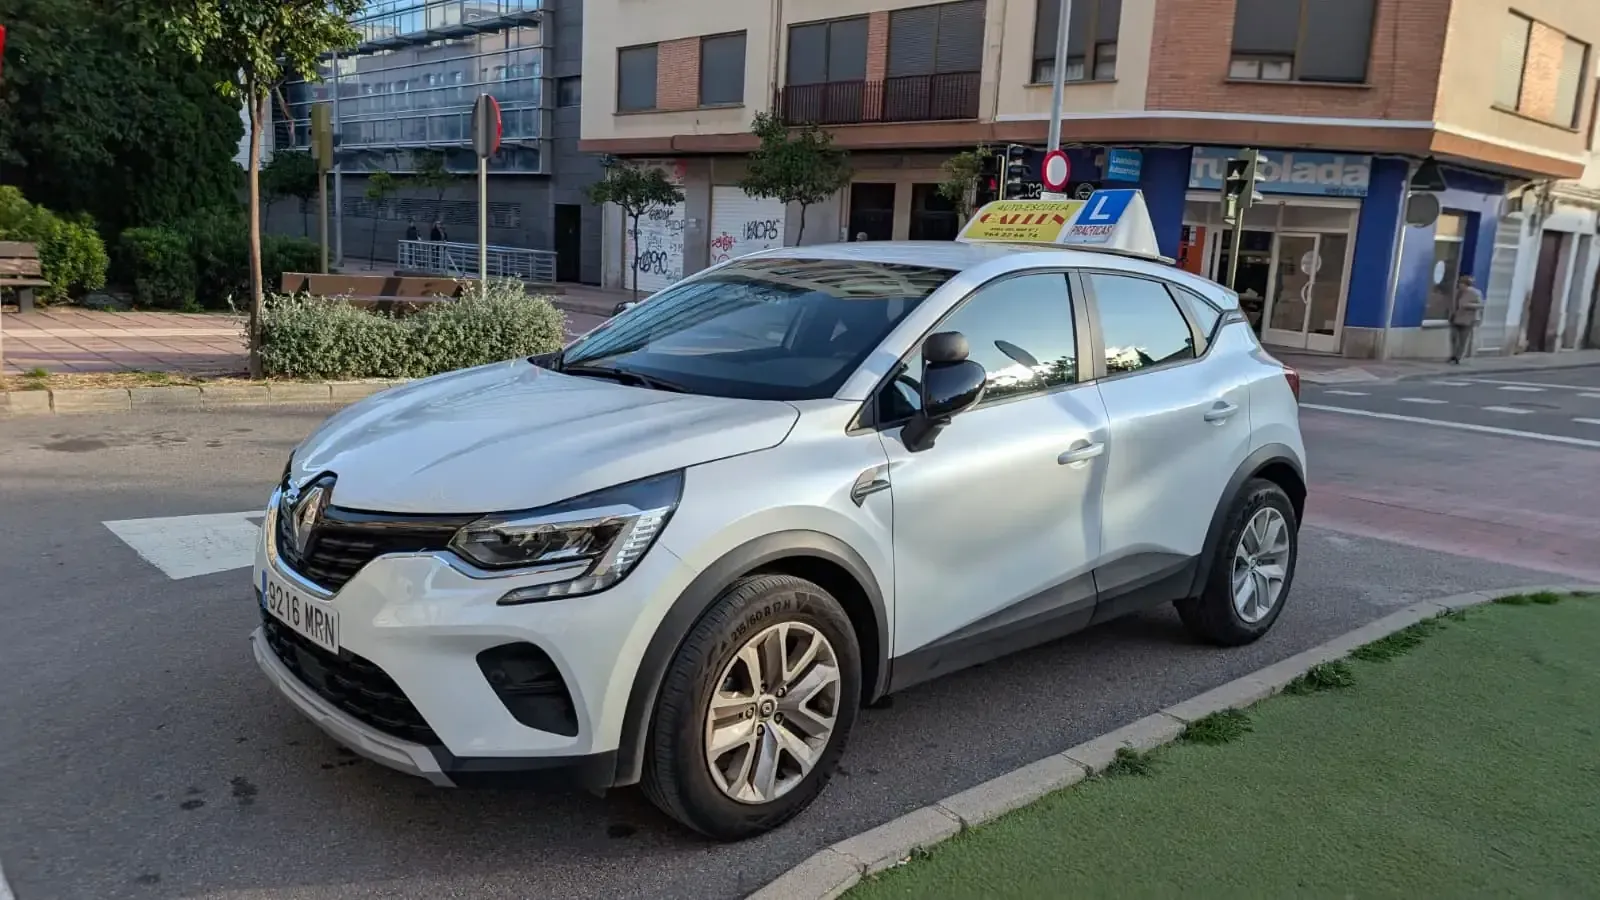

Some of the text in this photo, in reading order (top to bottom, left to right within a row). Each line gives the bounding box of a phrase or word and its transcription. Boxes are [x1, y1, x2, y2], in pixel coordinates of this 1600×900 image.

[1089, 195, 1111, 220] L
[268, 581, 335, 649] 9216 MRN
[731, 610, 763, 642] 215/60
